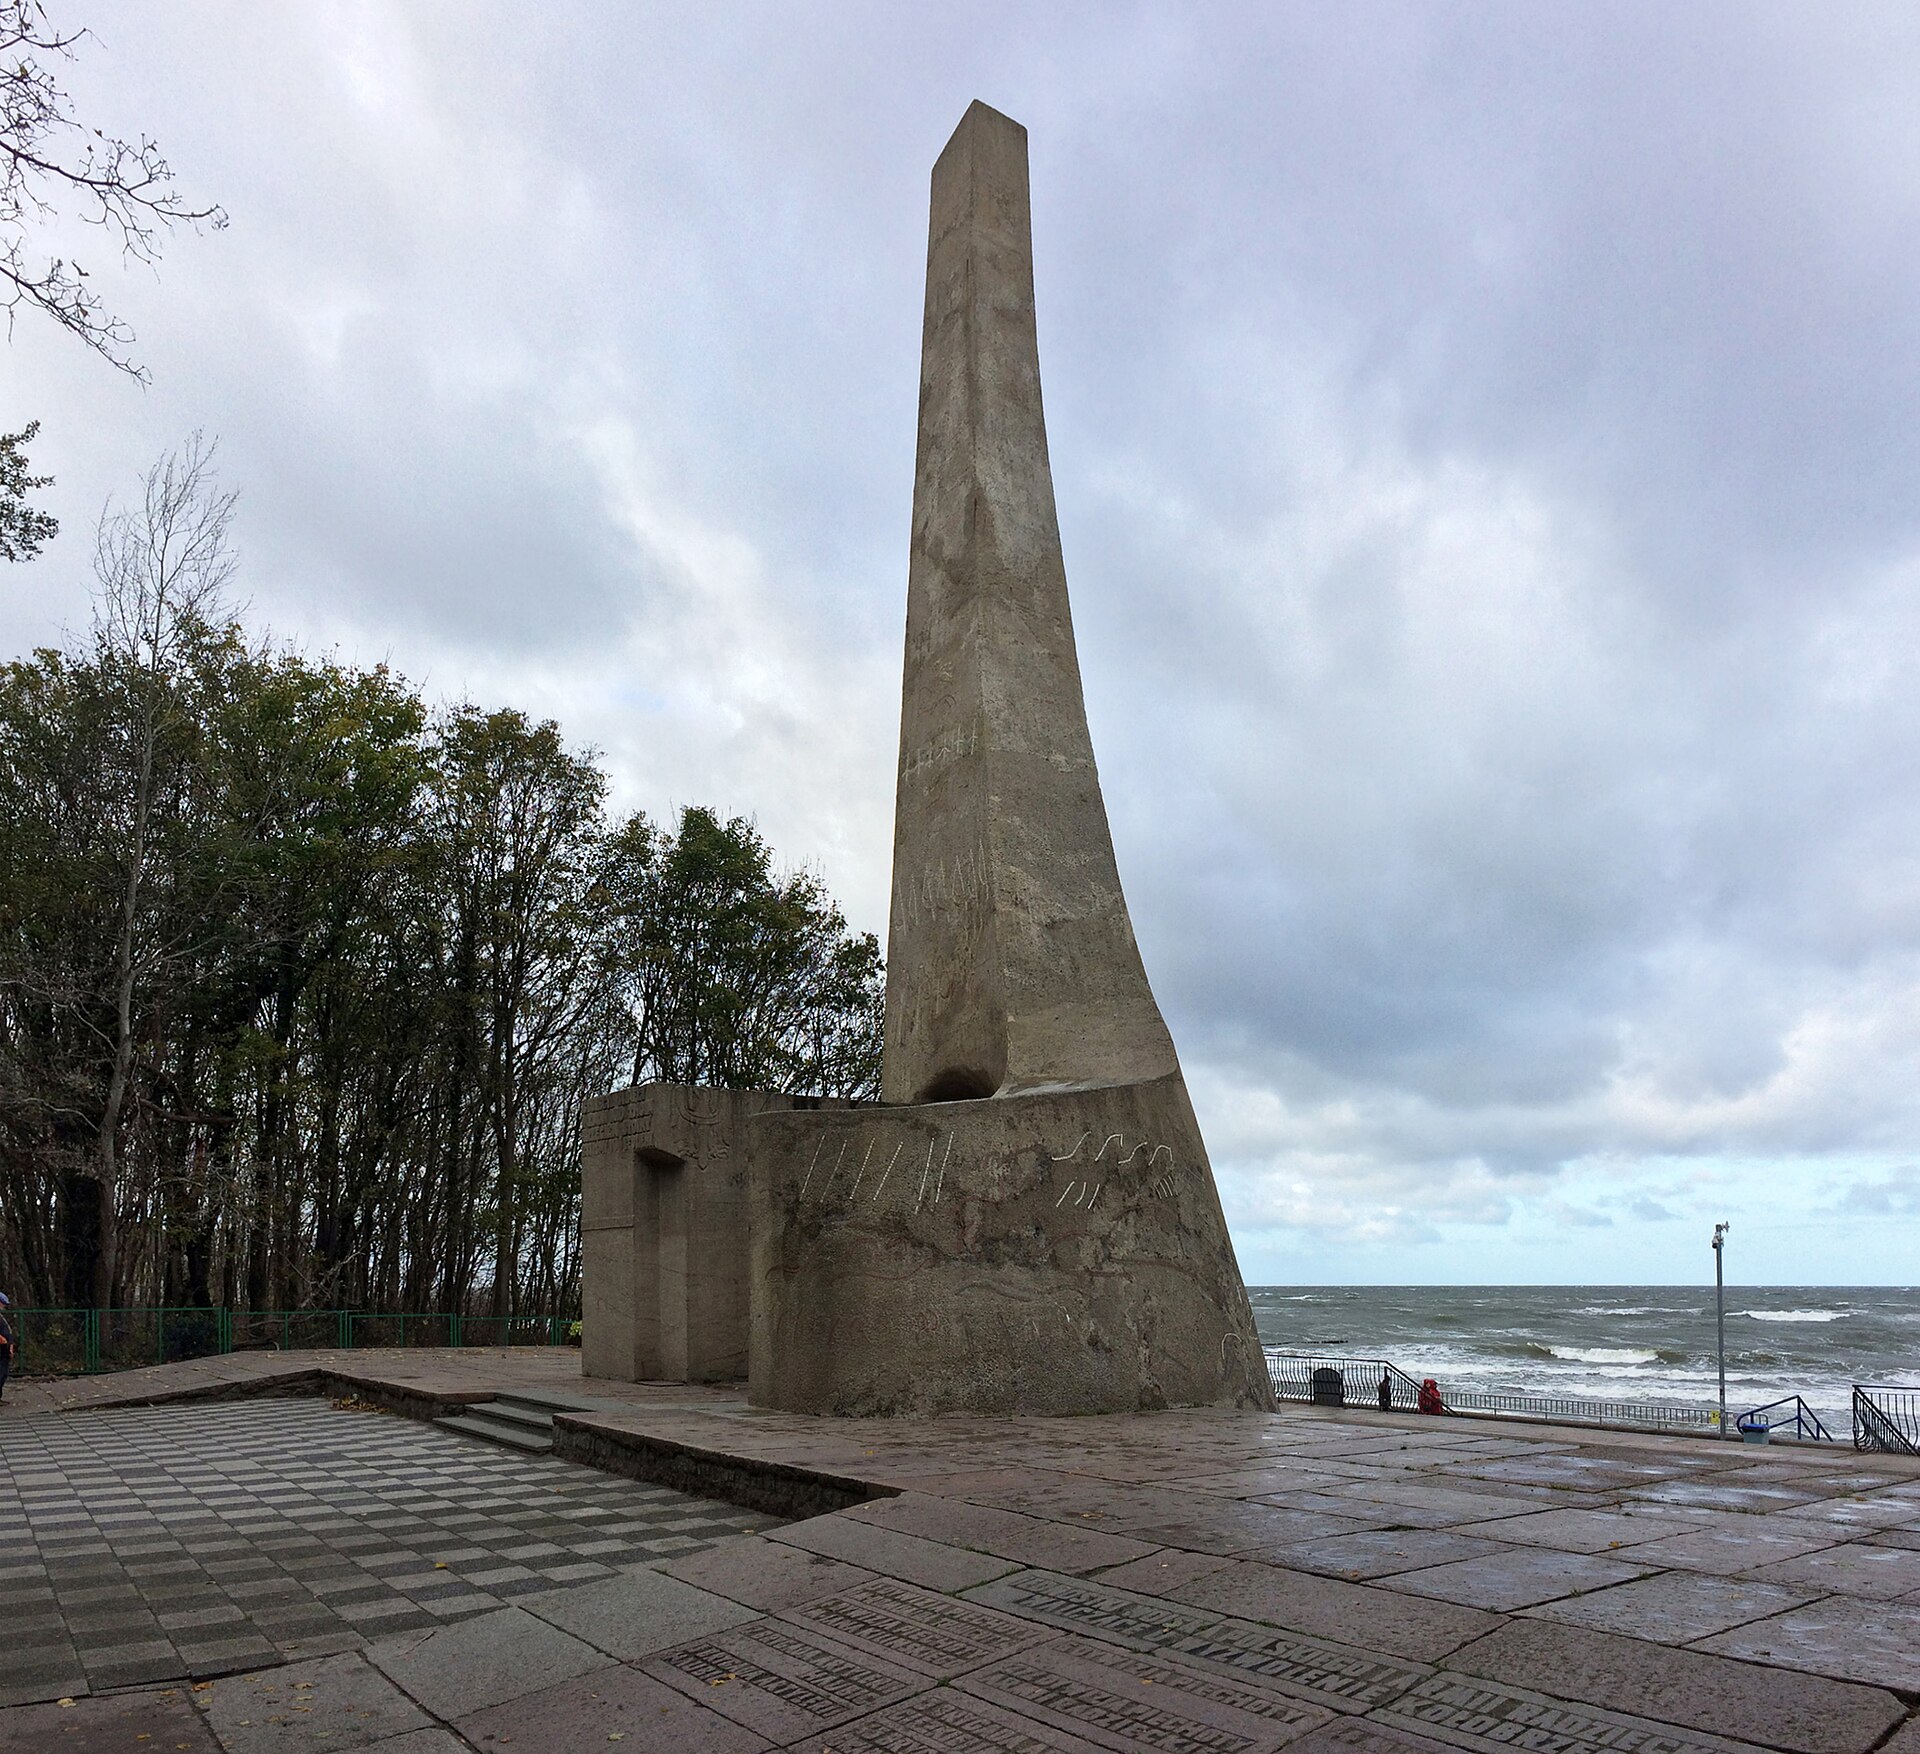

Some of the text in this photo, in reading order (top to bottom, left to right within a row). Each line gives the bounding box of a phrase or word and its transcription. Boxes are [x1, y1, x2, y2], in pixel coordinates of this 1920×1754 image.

[1164, 1674, 1311, 1726] PIECHOTY
[1166, 1636, 1391, 1702] WYZWOLENIE
[1211, 1628, 1379, 1678] POLSKIEGO
[1384, 1670, 1509, 1714] ARMII
